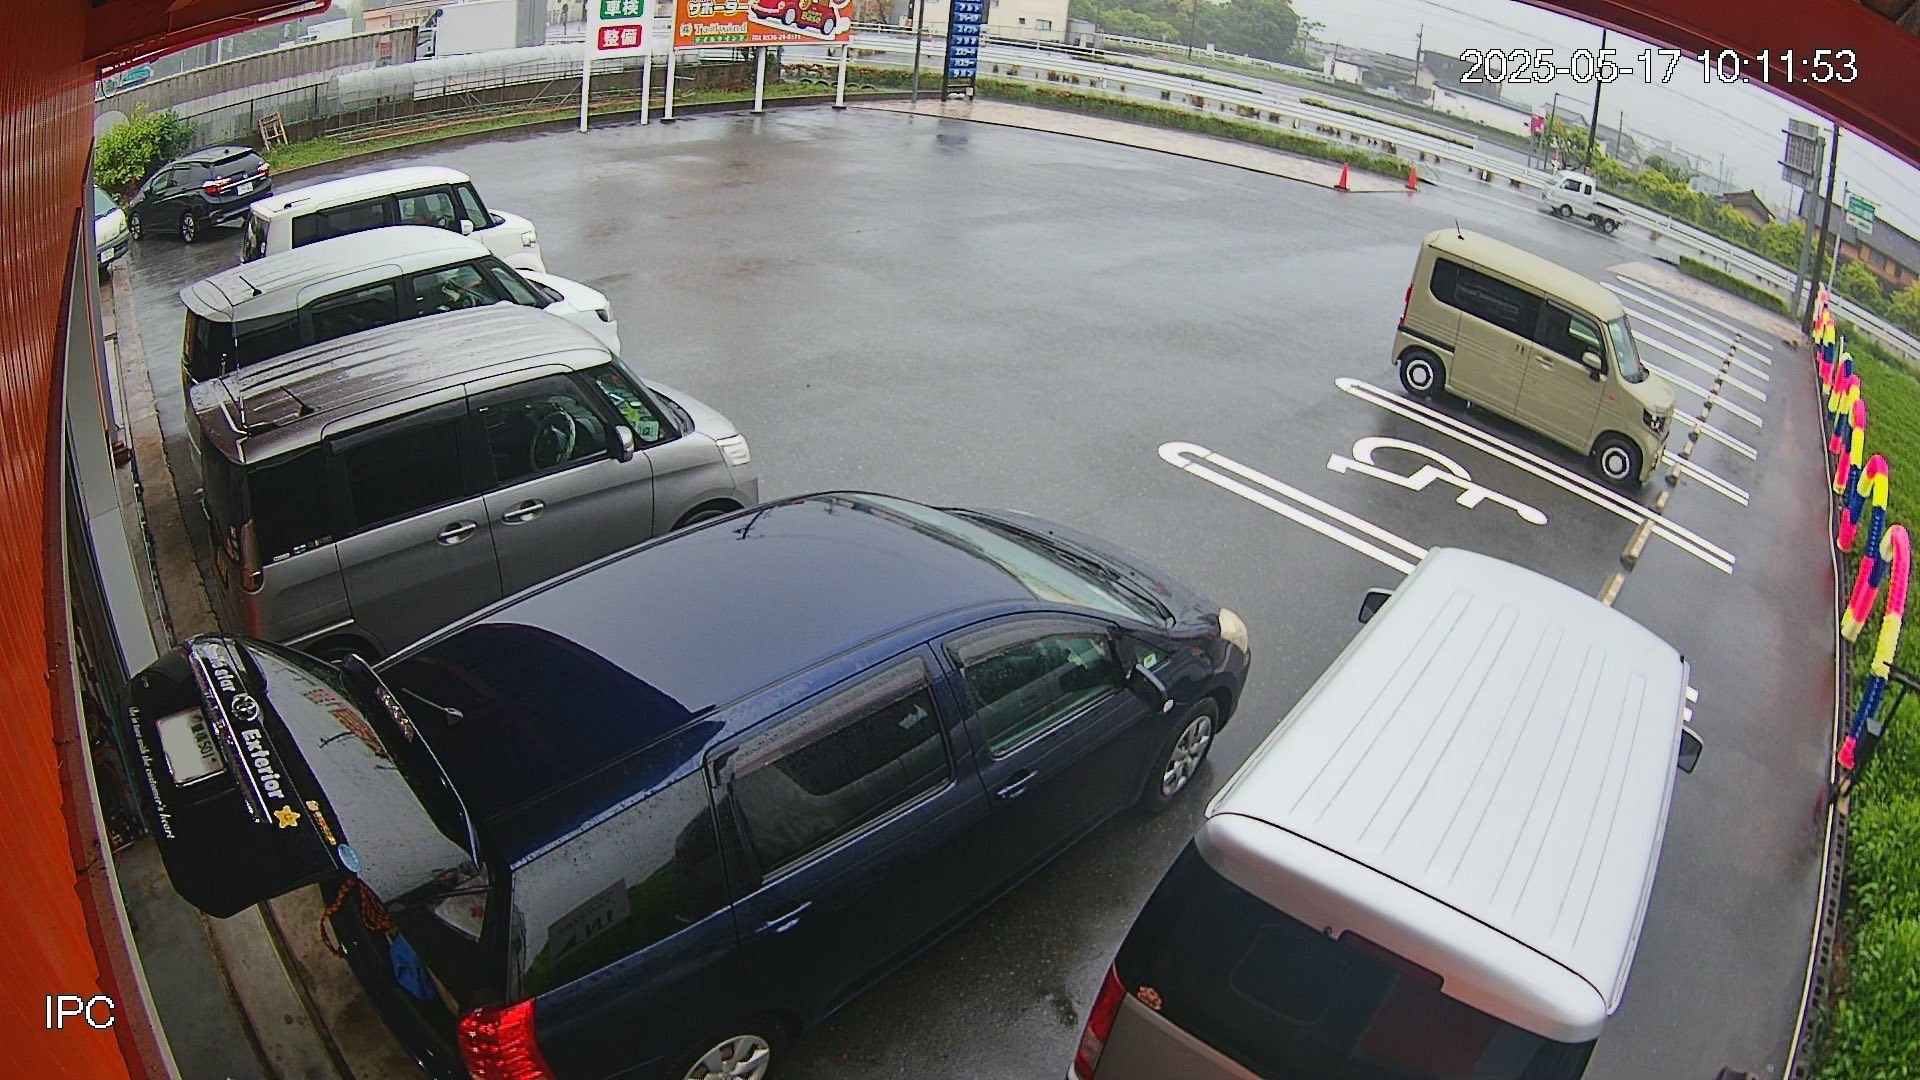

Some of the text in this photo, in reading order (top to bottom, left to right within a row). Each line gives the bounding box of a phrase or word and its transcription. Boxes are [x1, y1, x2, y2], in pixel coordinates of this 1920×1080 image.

[603, 29, 637, 47] 整備
[141, 755, 153, 767] the
[241, 728, 285, 799] Exterior
[145, 768, 167, 812] customer's
[159, 812, 175, 839] heart
